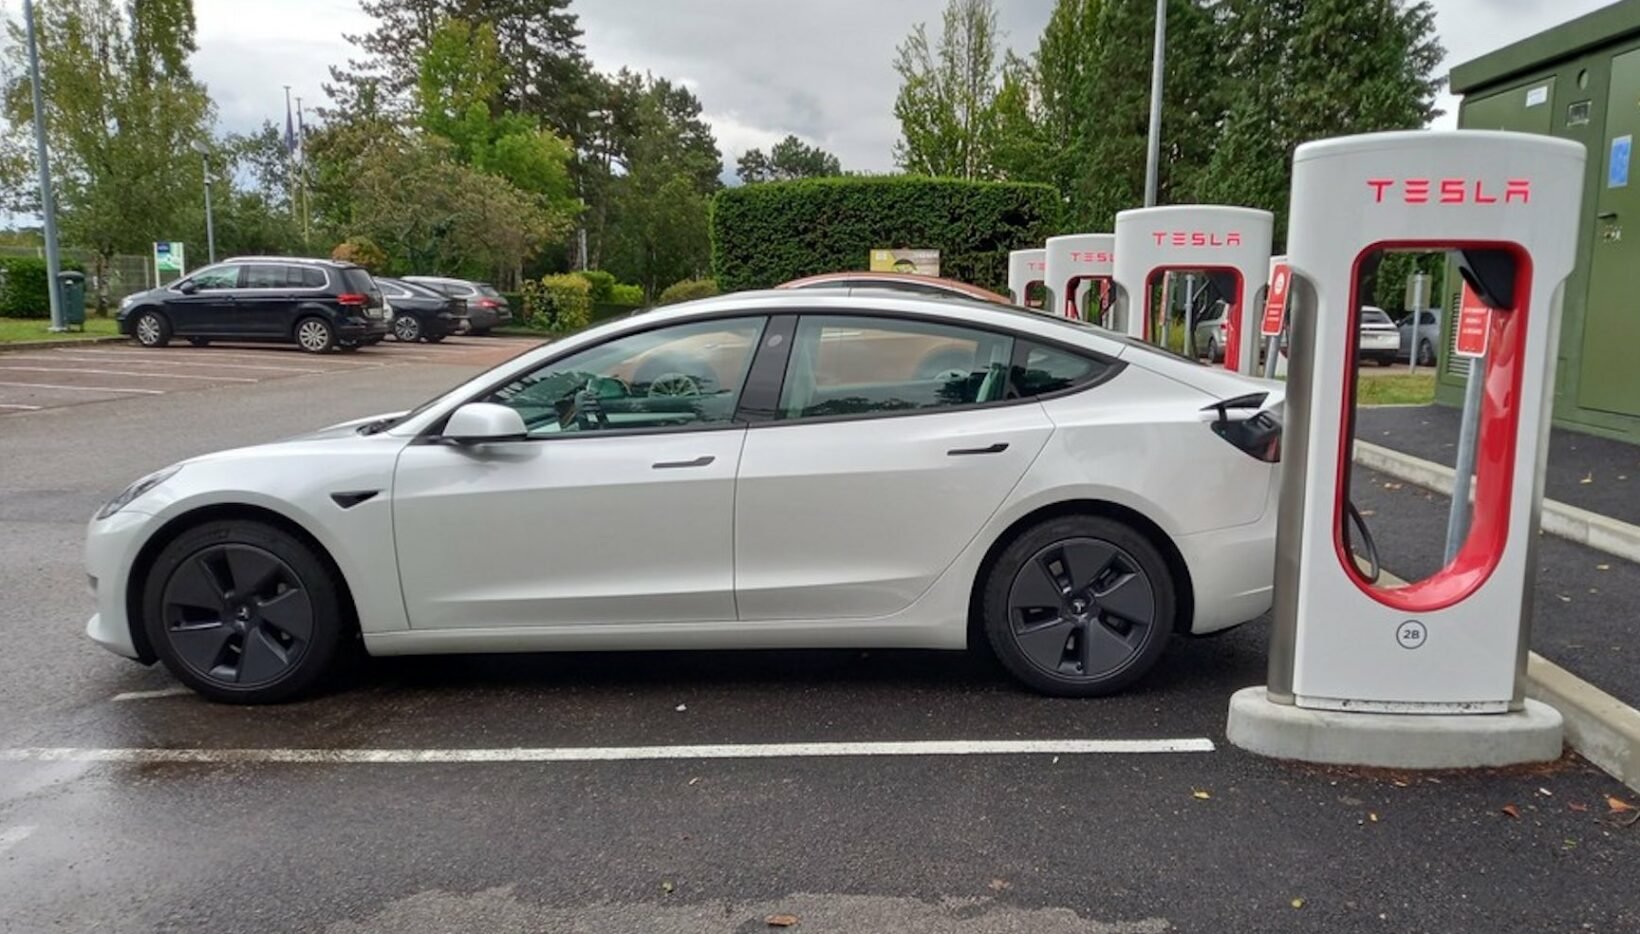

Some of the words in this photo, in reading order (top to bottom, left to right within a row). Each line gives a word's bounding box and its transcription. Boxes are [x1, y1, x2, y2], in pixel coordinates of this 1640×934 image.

[1367, 179, 1531, 204] TESLA
[1152, 232, 1241, 247] TESLA
[1403, 629, 1420, 639] 2B
